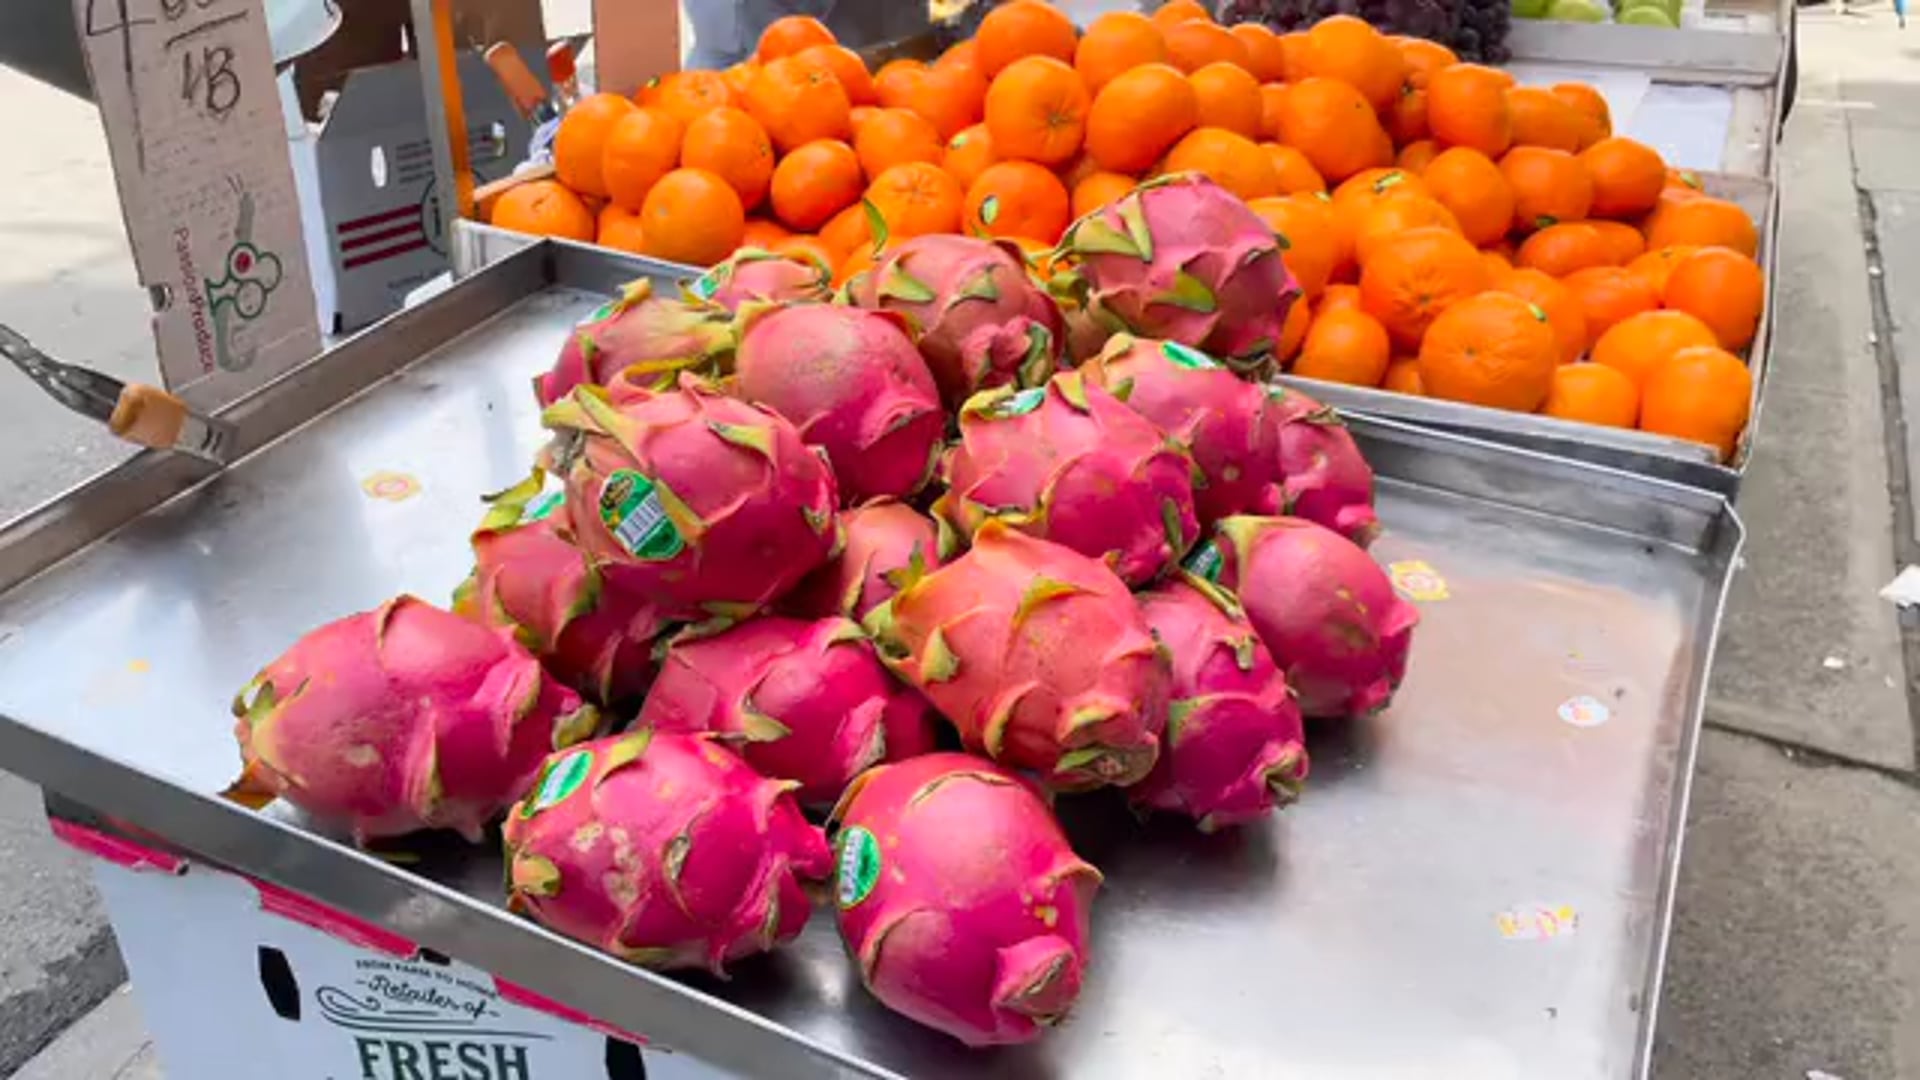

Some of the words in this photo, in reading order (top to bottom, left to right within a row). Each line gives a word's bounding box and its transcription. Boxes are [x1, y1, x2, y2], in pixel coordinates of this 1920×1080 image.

[367, 974, 460, 1010] Retailer
[462, 999, 487, 1019] of
[354, 1035, 530, 1080] FRESH
